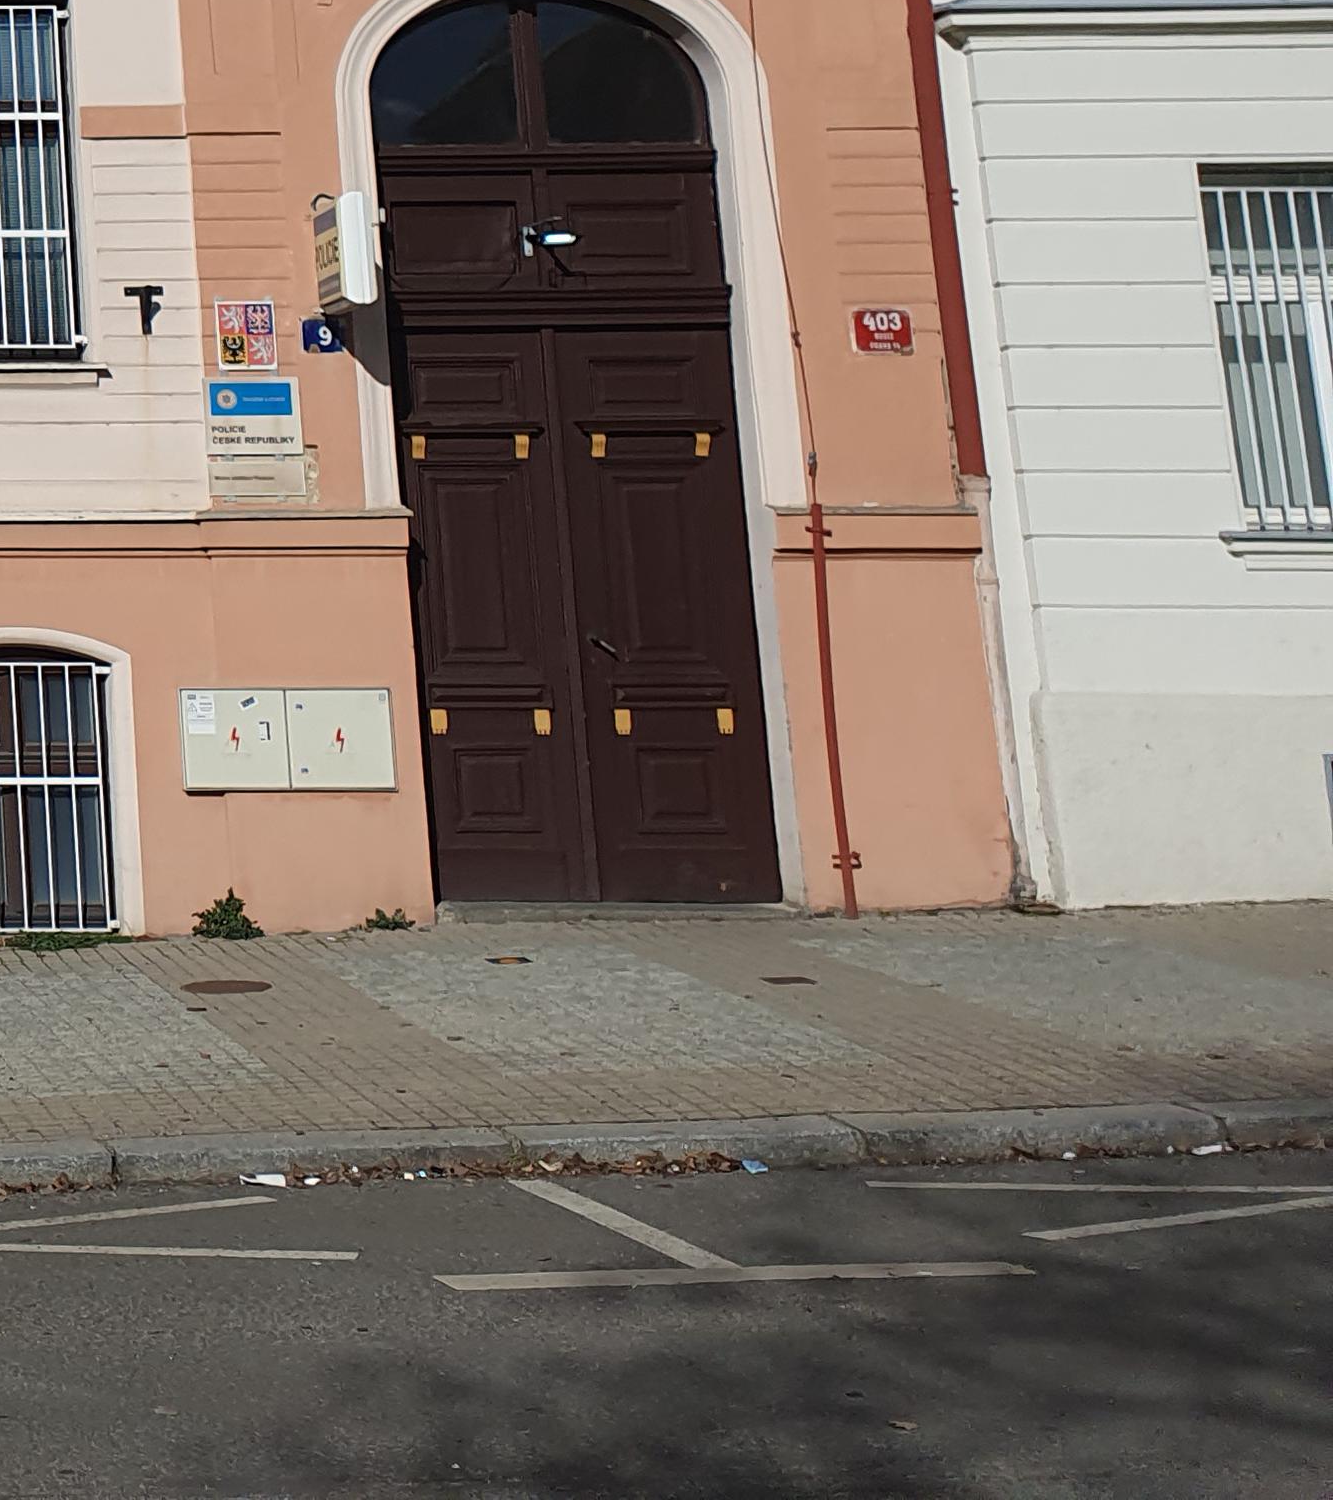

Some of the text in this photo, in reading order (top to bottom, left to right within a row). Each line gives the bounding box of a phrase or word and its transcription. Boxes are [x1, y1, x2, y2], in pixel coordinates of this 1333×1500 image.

[863, 312, 902, 331] 403
[318, 326, 333, 346] 9
[211, 425, 246, 433] POLICIE
[244, 436, 295, 445] REPUBLIKY
